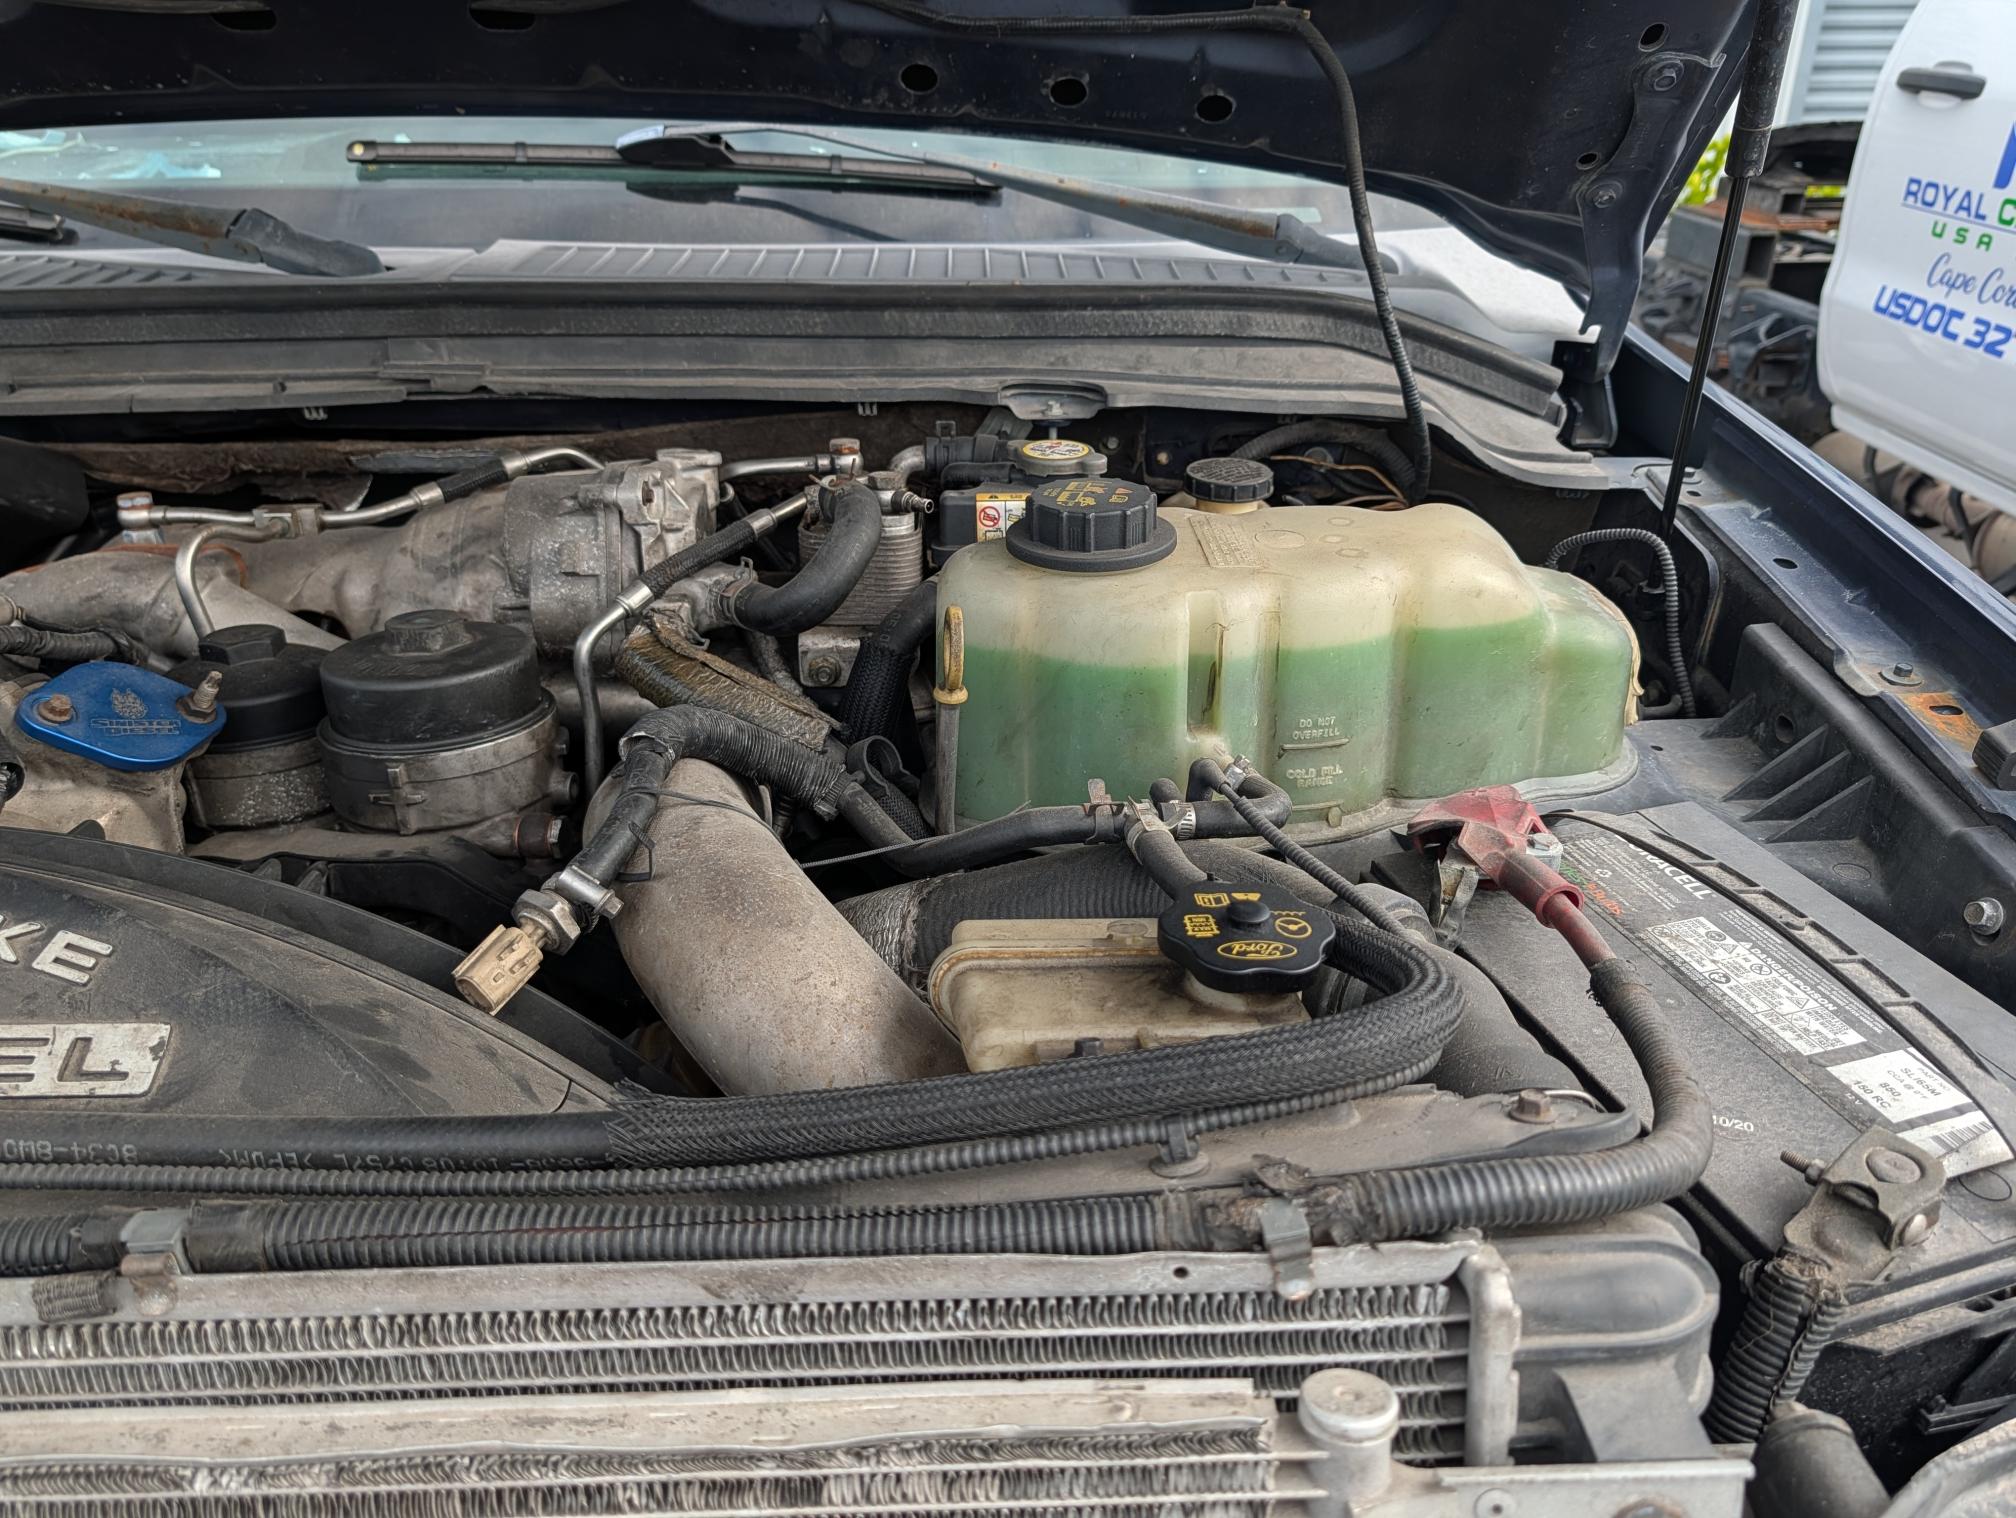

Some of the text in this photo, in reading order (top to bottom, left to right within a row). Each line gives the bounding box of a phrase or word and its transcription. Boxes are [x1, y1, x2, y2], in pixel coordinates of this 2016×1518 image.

[1903, 177, 1987, 221] ROYAL
[1931, 220, 1993, 251] USA
[1926, 252, 1977, 299] Cape
[1873, 284, 2016, 358] USDOC 32
[90, 718, 181, 729] SINISTER
[1299, 715, 1336, 728] DO NOT
[1292, 727, 1340, 740] OVERFILL
[1286, 767, 1317, 779] COLD
[1871, 1094, 1892, 1109] RC
[1711, 1114, 1754, 1132] 10/20
